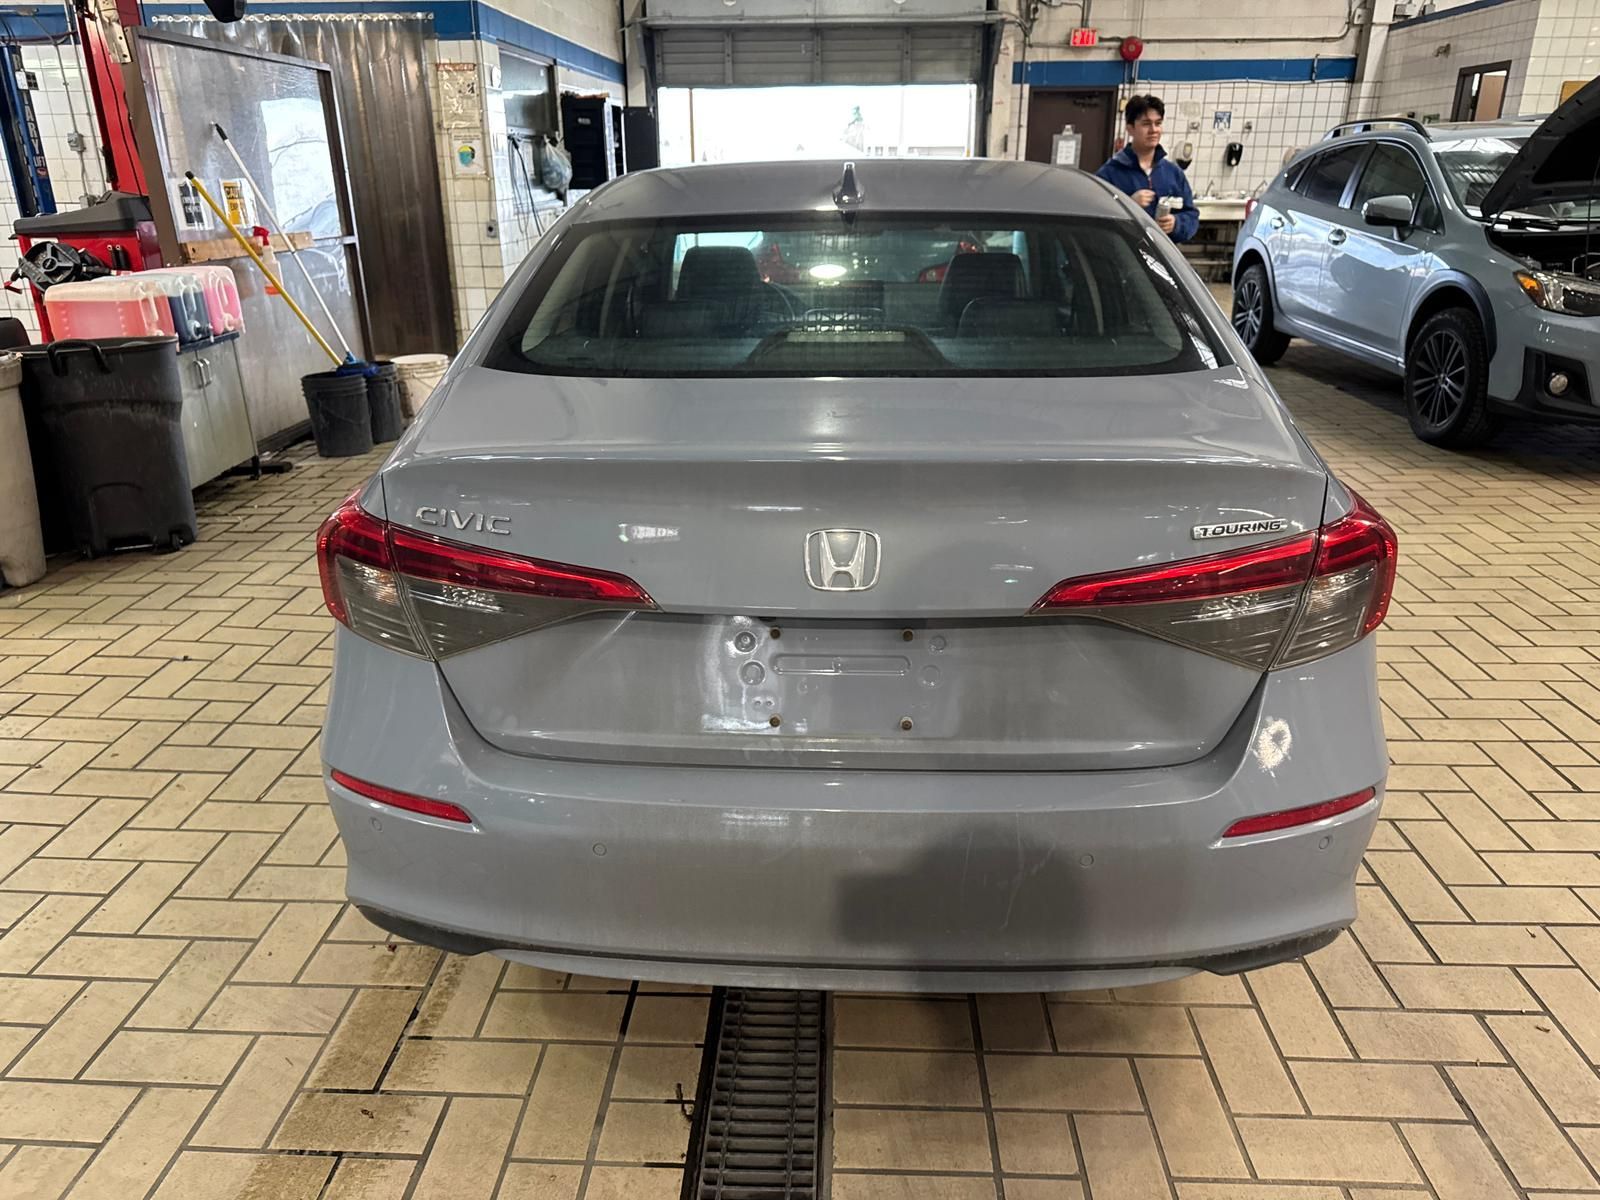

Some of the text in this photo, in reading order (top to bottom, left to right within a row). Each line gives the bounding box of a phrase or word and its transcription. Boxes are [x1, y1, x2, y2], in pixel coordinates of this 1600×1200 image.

[1072, 31, 1096, 46] EXIT
[12, 53, 41, 155] RTARY
[33, 156, 46, 167] LIFT
[416, 506, 511, 535] CIVIC
[1200, 520, 1281, 537] TOURING
